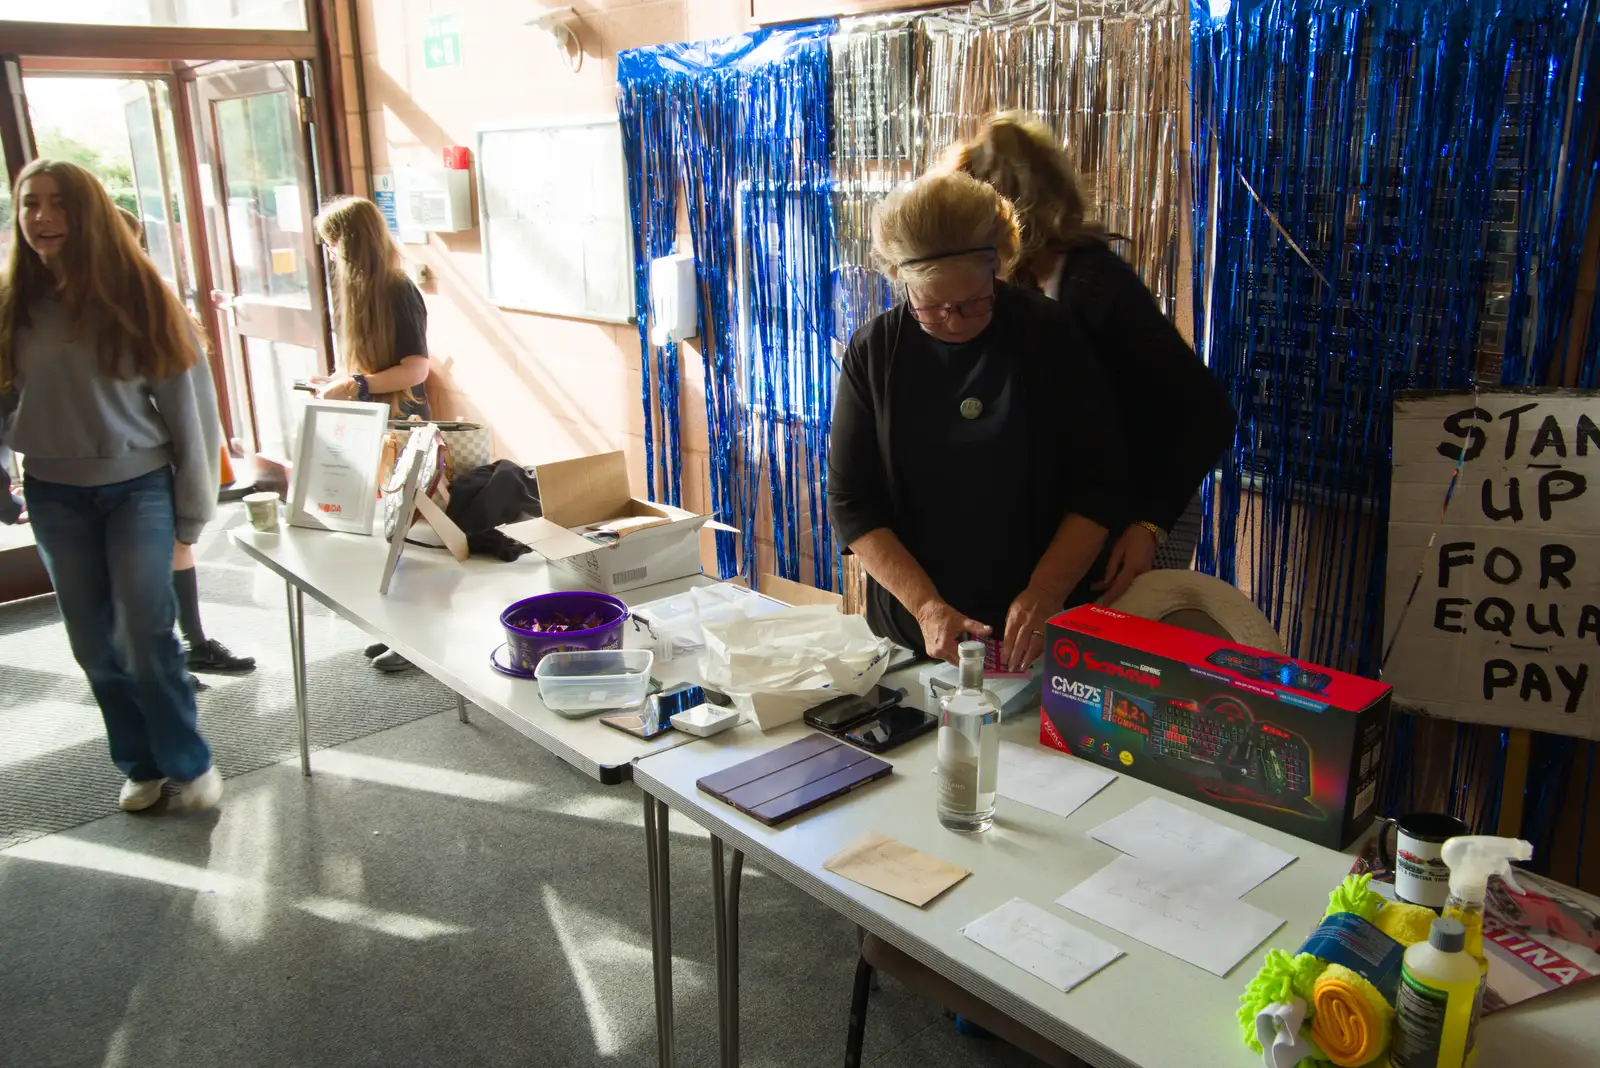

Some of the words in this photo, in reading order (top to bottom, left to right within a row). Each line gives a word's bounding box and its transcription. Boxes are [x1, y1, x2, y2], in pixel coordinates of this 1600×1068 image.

[1436, 403, 1600, 462] STAN
[1481, 470, 1587, 523] UP
[1437, 541, 1577, 590] FOR
[1434, 597, 1600, 646] EQUA
[1051, 675, 1102, 703] CM375
[1139, 664, 1162, 676] GAMING
[1483, 659, 1590, 713] PAY
